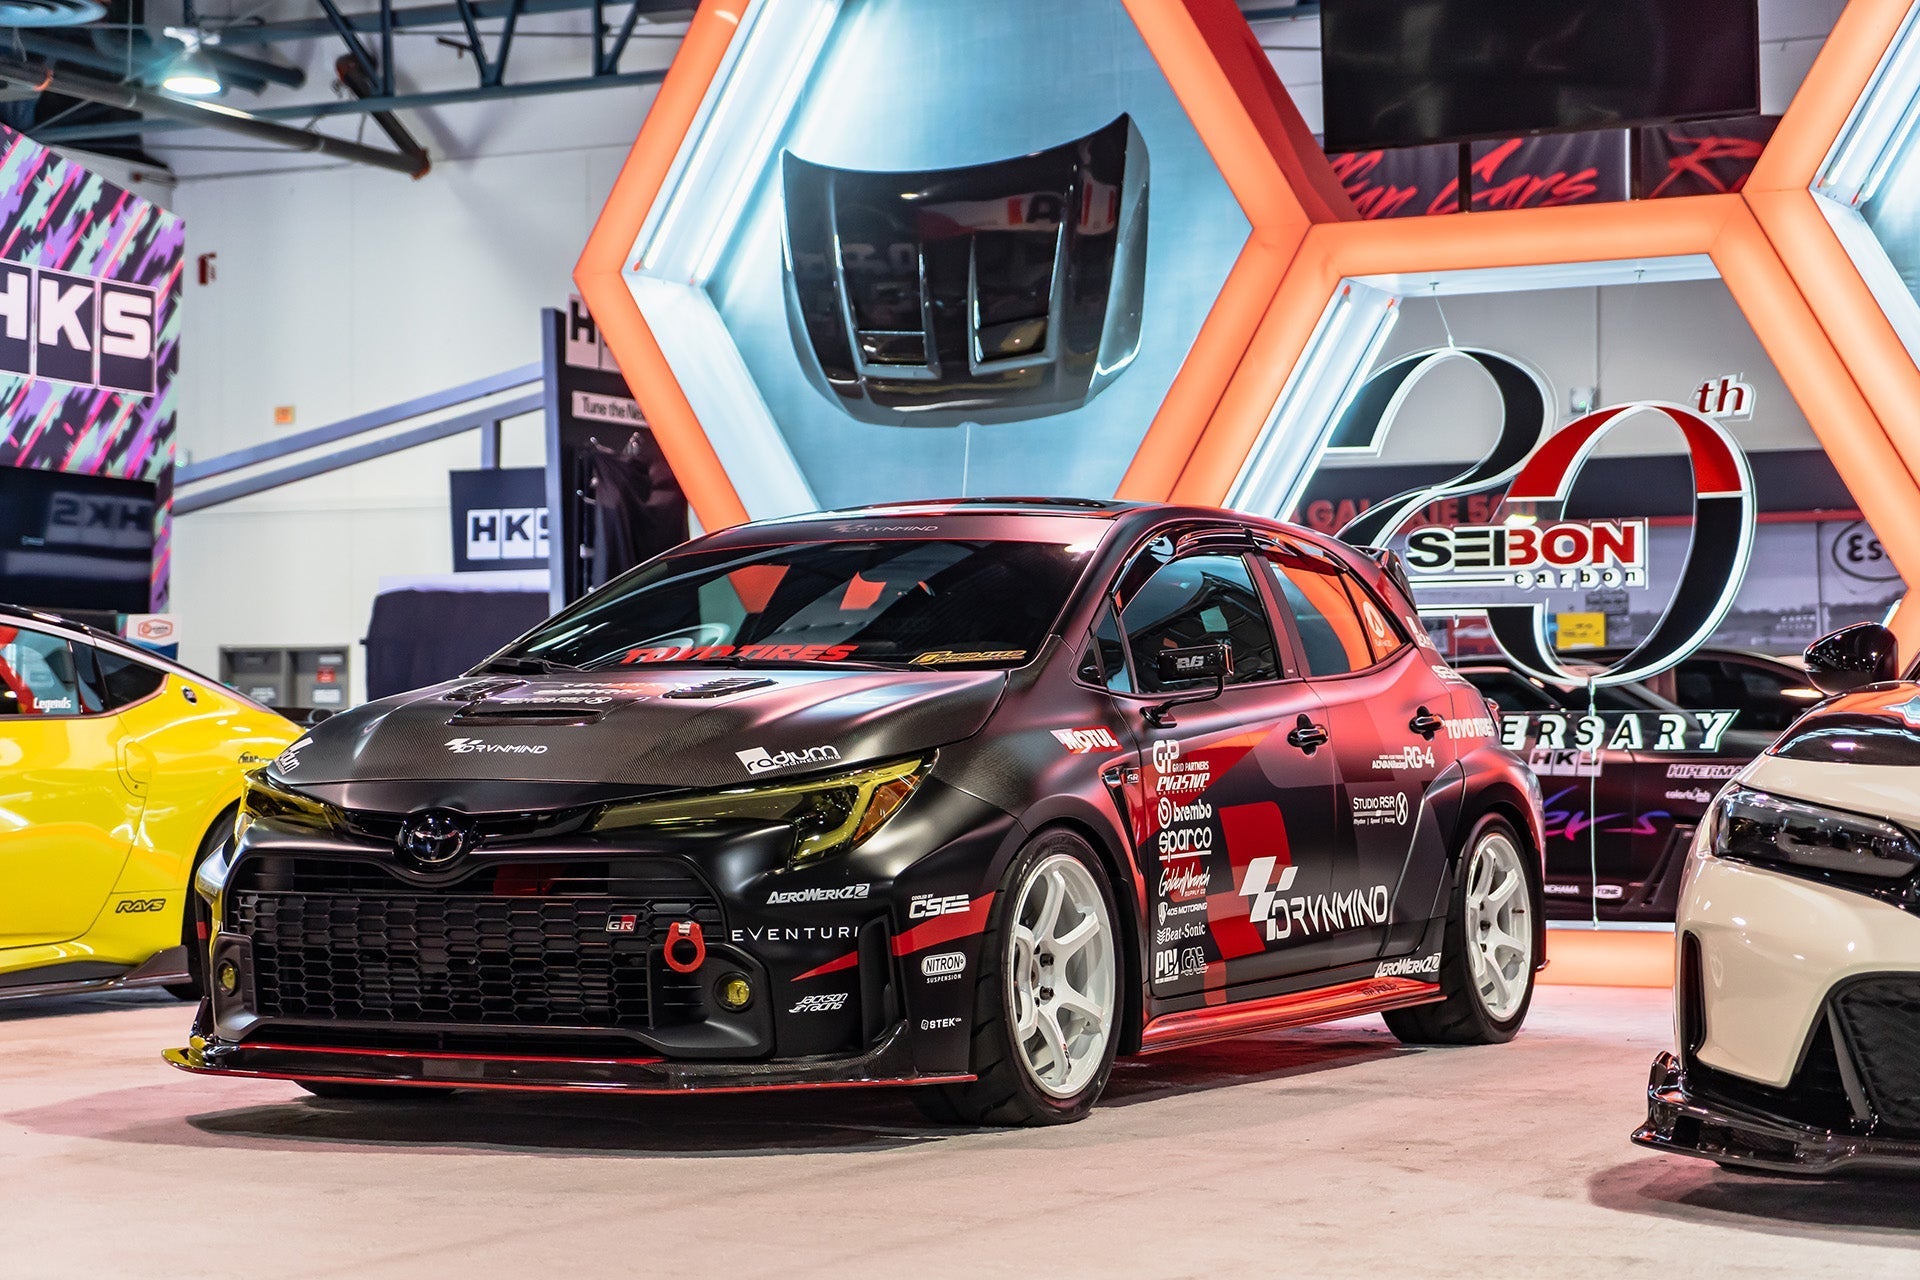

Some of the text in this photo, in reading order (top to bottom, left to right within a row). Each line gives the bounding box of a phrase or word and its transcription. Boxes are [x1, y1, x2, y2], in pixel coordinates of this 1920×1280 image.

[582, 396, 607, 416] Tune
[609, 402, 626, 418] the
[1695, 376, 1746, 418] th
[1407, 521, 1637, 570] SEIBON
[1513, 567, 1637, 586] carbon
[620, 644, 859, 665] TOYO TIRES
[33, 696, 72, 713] Legends
[1445, 718, 1475, 740] TOYO
[1058, 729, 1119, 752] MOTUL
[746, 745, 841, 772] radium
[1152, 739, 1180, 774] GP
[1172, 760, 1210, 773] GRID PARTNERS
[1403, 745, 1435, 769] RG-4
[1667, 764, 1745, 779] HIPERMA
[1173, 799, 1212, 822] brembo
[1353, 795, 1395, 810] STUDIO RSR
[1159, 827, 1212, 863] sparco
[115, 898, 166, 913] RAYS
[1178, 901, 1208, 915] MOTORING
[1268, 885, 1389, 941] DRVNMIND
[608, 921, 634, 930] GR
[731, 926, 859, 942] EVENTURI
[1164, 921, 1206, 943] Beat-Sonic
[925, 957, 961, 973] NITRON
[926, 973, 962, 984] SUSPENSION
[929, 1018, 955, 1029] STEK
